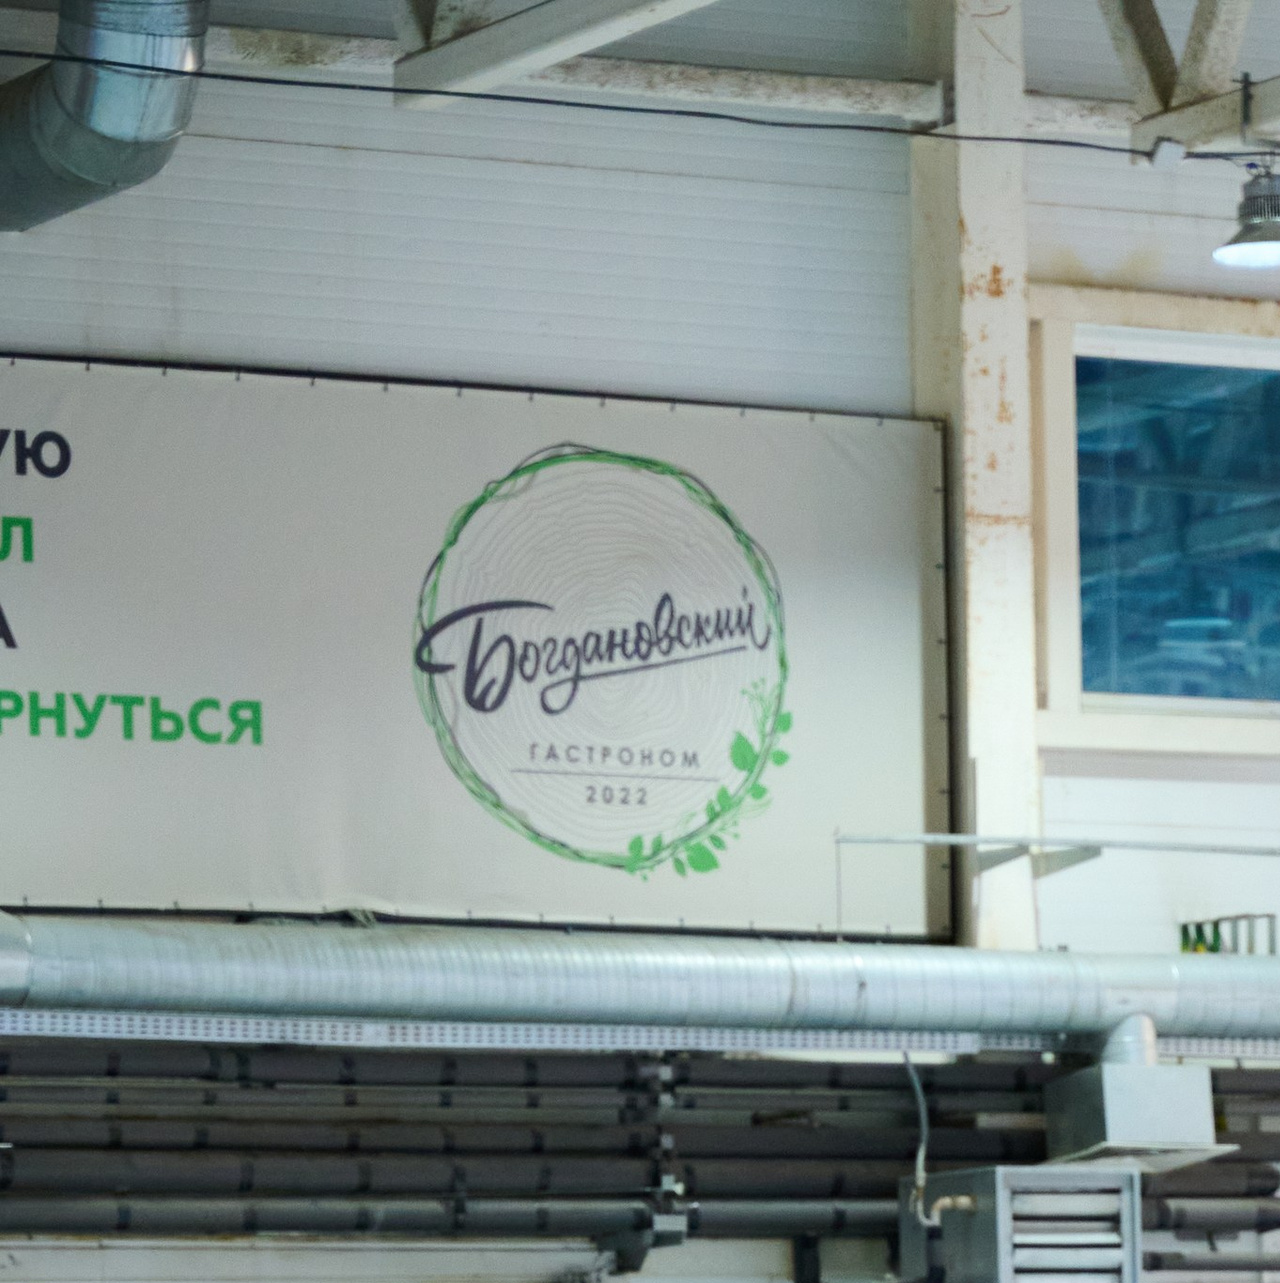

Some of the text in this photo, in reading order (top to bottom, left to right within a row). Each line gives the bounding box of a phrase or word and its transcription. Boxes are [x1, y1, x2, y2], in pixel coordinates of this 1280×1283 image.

[415, 586, 772, 715] Богдановский
[528, 743, 701, 768] ГАСТРОНОМ
[585, 786, 648, 805] 2022
